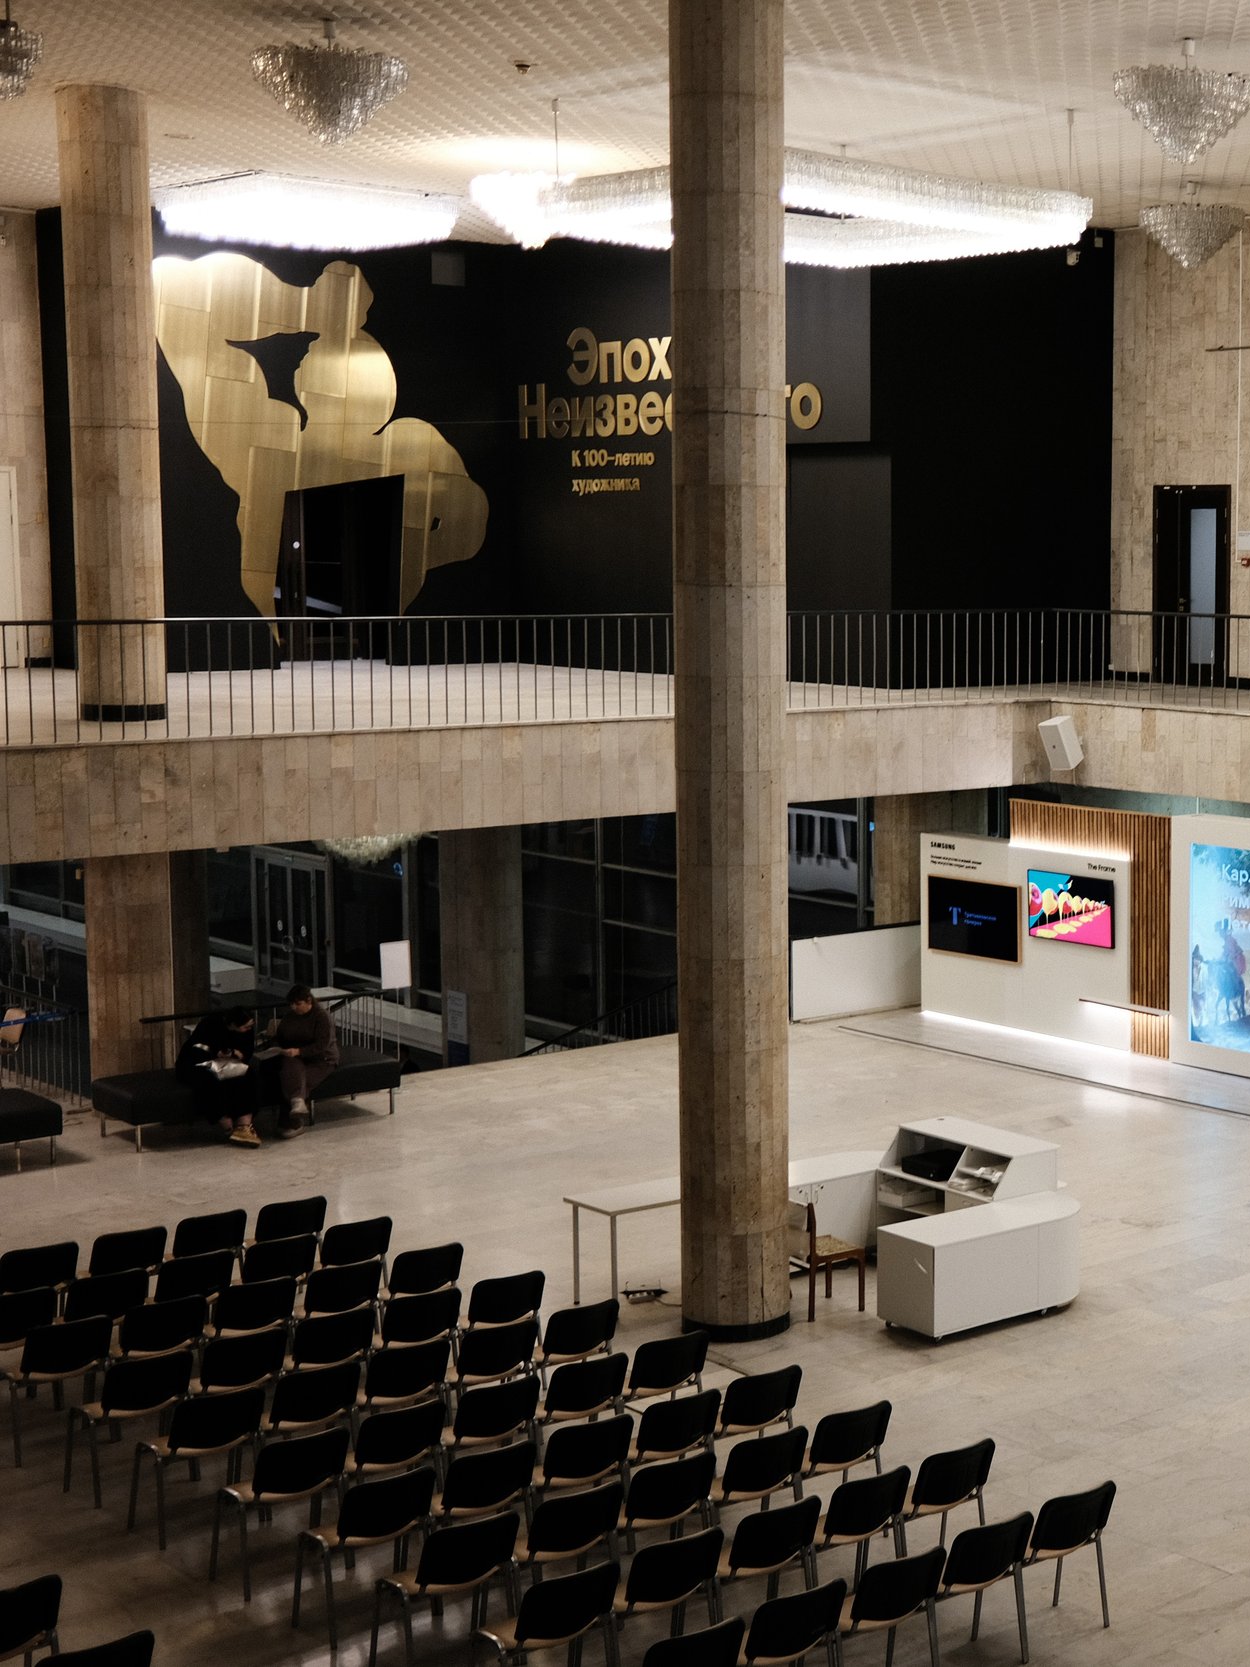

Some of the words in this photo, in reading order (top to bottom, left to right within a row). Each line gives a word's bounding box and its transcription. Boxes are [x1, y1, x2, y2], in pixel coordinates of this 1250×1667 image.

[566, 326, 673, 386] Эпох
[518, 381, 823, 440] Неизвео
[572, 450, 581, 467] К
[572, 476, 641, 496] художника
[930, 841, 956, 850] SAMSUNG
[1098, 864, 1116, 873] Frame
